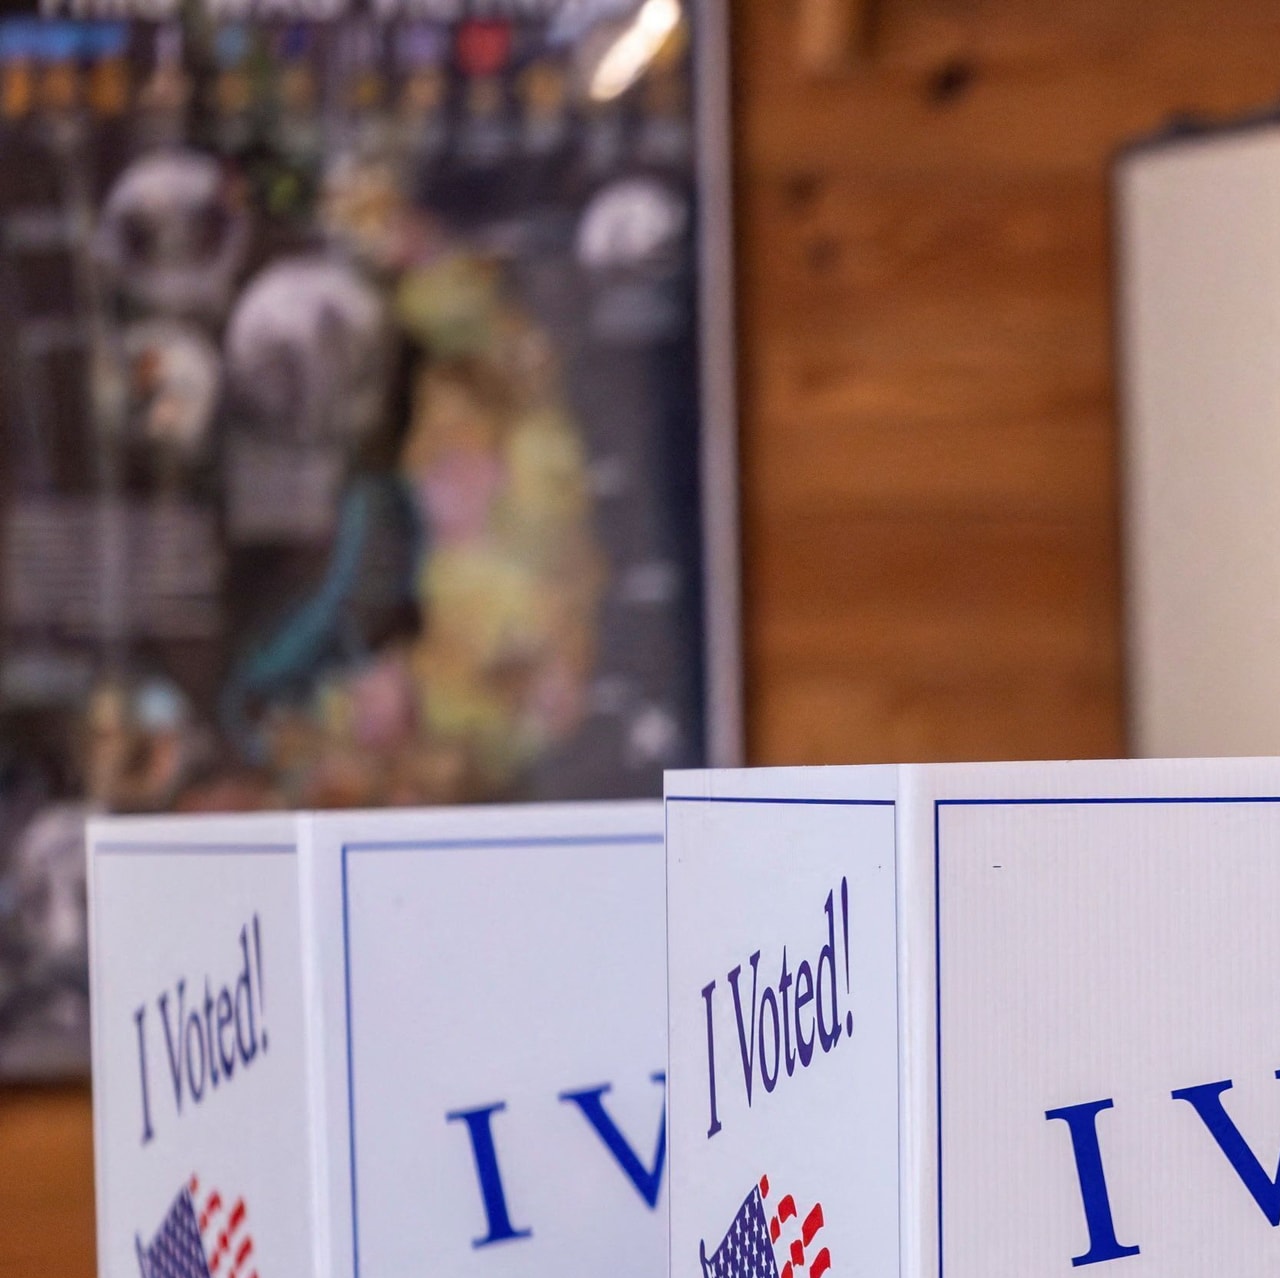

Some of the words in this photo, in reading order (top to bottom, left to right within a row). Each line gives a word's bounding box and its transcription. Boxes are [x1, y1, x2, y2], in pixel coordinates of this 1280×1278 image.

[134, 1003, 155, 1146] I
[157, 912, 269, 1114] Voted!
[700, 979, 723, 1140] I
[728, 876, 854, 1109] Voted!
[445, 1101, 533, 1250] I
[1044, 1098, 1141, 1268] I
